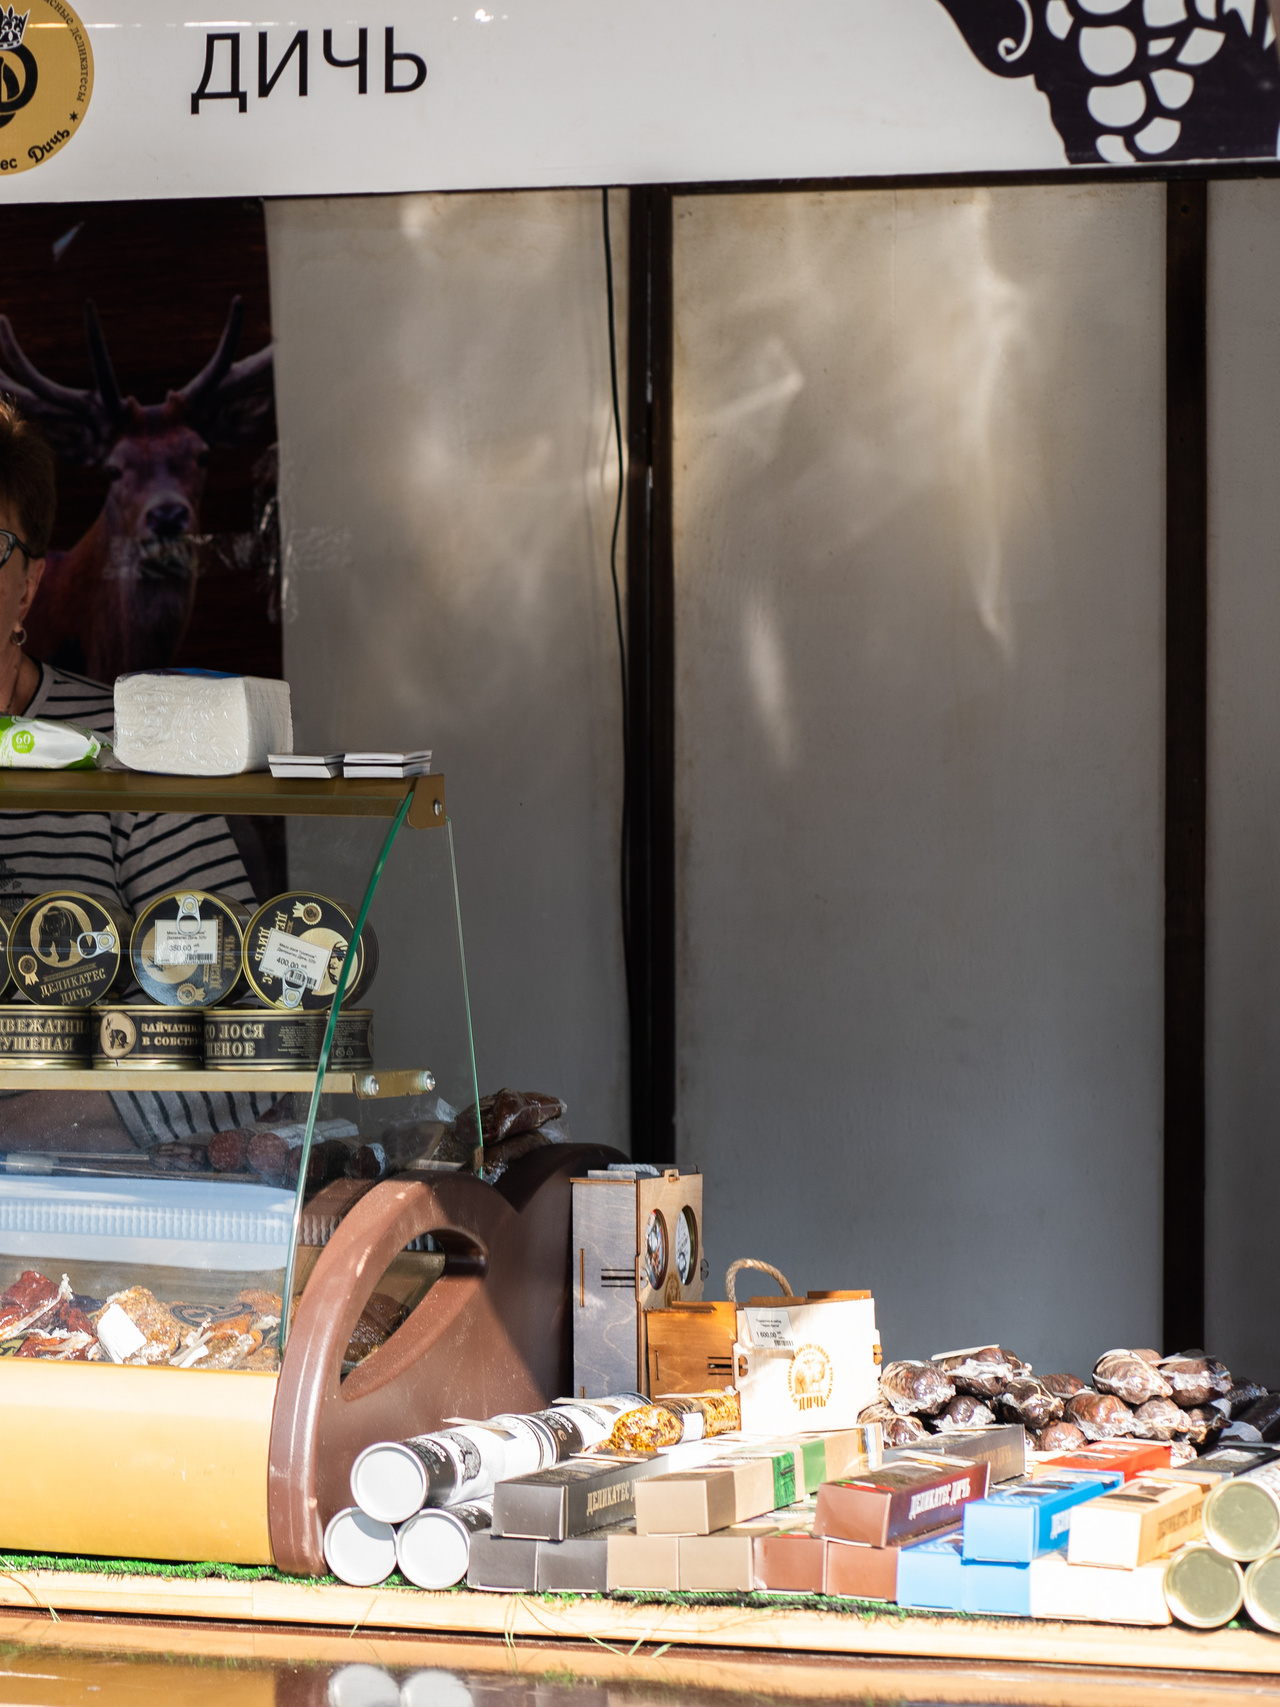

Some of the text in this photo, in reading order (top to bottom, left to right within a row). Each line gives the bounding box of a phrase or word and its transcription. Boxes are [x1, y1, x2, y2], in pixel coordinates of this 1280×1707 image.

[191, 26, 428, 115] ДИЧЬ
[27, 128, 71, 164] Дичь
[15, 733, 31, 745] 60
[276, 957, 299, 969] 400,00
[40, 967, 107, 998] ДЕЛИКАТЕС
[60, 987, 92, 1005] ДИЧЬ
[141, 1036, 150, 1045] В
[219, 1023, 265, 1040] ЛОСЯ
[798, 1395, 827, 1411] ДИЧЬ
[586, 1481, 630, 1517] ДЕЛИКАТЕС
[908, 1477, 971, 1521] ДЕЛИКАТЕС ДИЧЬ
